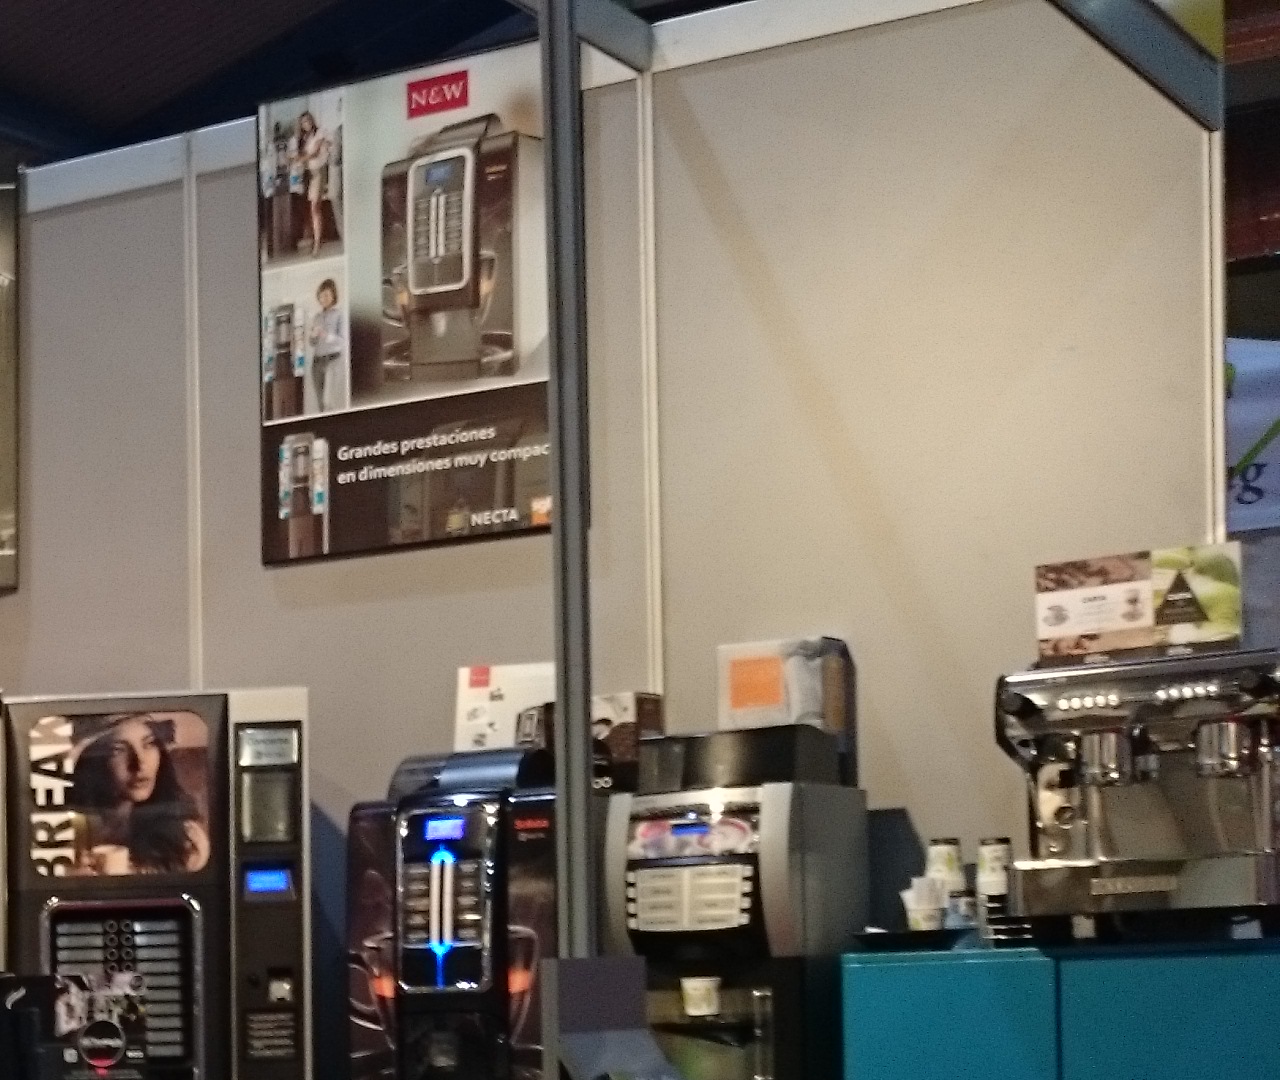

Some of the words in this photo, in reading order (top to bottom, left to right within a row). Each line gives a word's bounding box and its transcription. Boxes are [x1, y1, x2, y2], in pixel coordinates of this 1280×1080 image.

[409, 81, 465, 109] N&W
[337, 440, 399, 461] Grandes
[399, 426, 496, 455] prestaciones
[337, 471, 357, 485] en
[358, 456, 452, 482] dimensiones
[454, 451, 490, 468] muy
[470, 508, 520, 527] NECTA
[29, 716, 75, 877] BREAK
